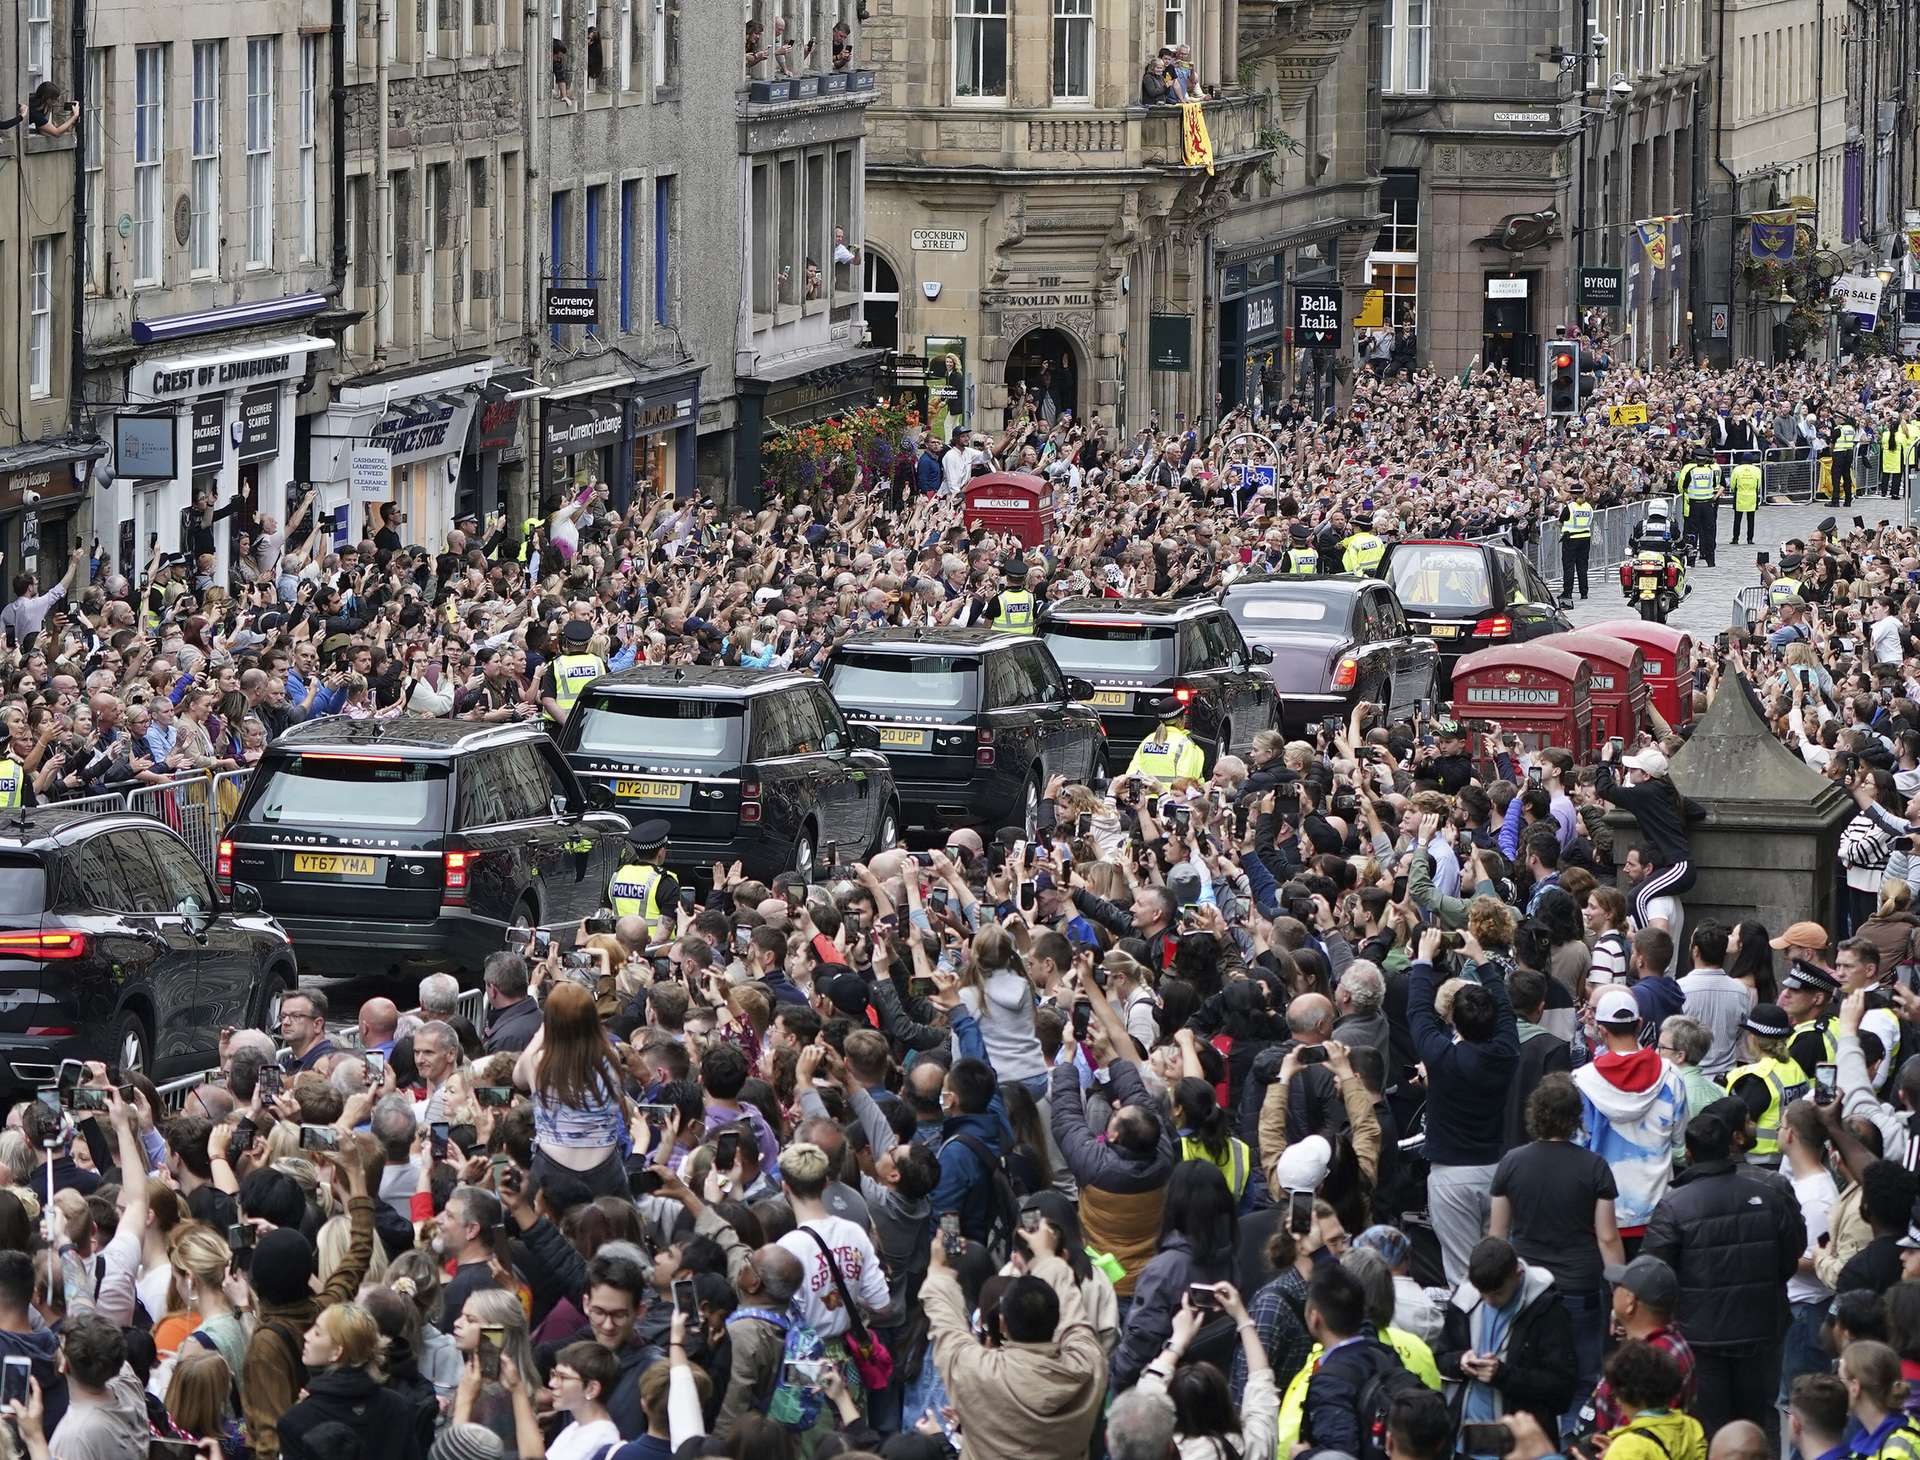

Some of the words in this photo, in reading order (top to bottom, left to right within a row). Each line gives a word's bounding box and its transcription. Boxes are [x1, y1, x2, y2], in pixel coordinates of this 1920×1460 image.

[913, 230, 965, 240] COCKBURN
[922, 240, 955, 249] STREET
[1038, 276, 1061, 287] THE
[1584, 277, 1617, 288] BYRON
[1009, 295, 1061, 306] WOOLLEN
[1063, 294, 1091, 305] MILL
[1832, 288, 1850, 298] FOR
[1851, 289, 1877, 301] SALE
[550, 296, 593, 308] Currency
[1300, 295, 1337, 312] Bella
[549, 306, 594, 318] Exchange
[1247, 301, 1260, 332] Bella
[1260, 298, 1274, 327] Italia
[1300, 313, 1338, 329] Italia
[153, 369, 194, 394] CREST
[198, 366, 215, 386] OF
[219, 355, 290, 382] EDINBURGH
[797, 388, 809, 404] THE
[931, 388, 958, 396] Barbour
[246, 402, 272, 416] CASHMERE
[201, 414, 213, 426] KILT
[634, 403, 677, 428] BALMORAL
[248, 415, 270, 429] SCARVES
[569, 423, 594, 441] Currency
[594, 415, 622, 434] Exchange
[193, 425, 220, 439] PACKAGES
[416, 422, 450, 450] STORE
[9, 474, 29, 491] Whisky
[28, 471, 50, 487] Tastings
[989, 499, 1012, 507] CASH
[25, 511, 36, 521] THE
[1772, 585, 1790, 594] POLICE
[1007, 603, 1029, 613] POLICE
[1433, 627, 1450, 635] 597
[567, 666, 596, 677] POLICE
[1472, 689, 1555, 703] TELEPHONE
[843, 713, 886, 721] RANGE
[895, 715, 943, 723] ROVER
[881, 730, 895, 741] 20
[898, 731, 920, 742] UPP
[1143, 742, 1169, 754] POLICE
[590, 763, 640, 772] RANGE
[650, 766, 703, 775] ROVER
[617, 782, 650, 794] OY20
[653, 783, 678, 796] URD
[271, 835, 328, 844] RANGE
[339, 838, 400, 847] ROVER
[301, 856, 337, 871] YT67
[341, 858, 368, 873] YMA
[613, 884, 645, 898] POLICE
